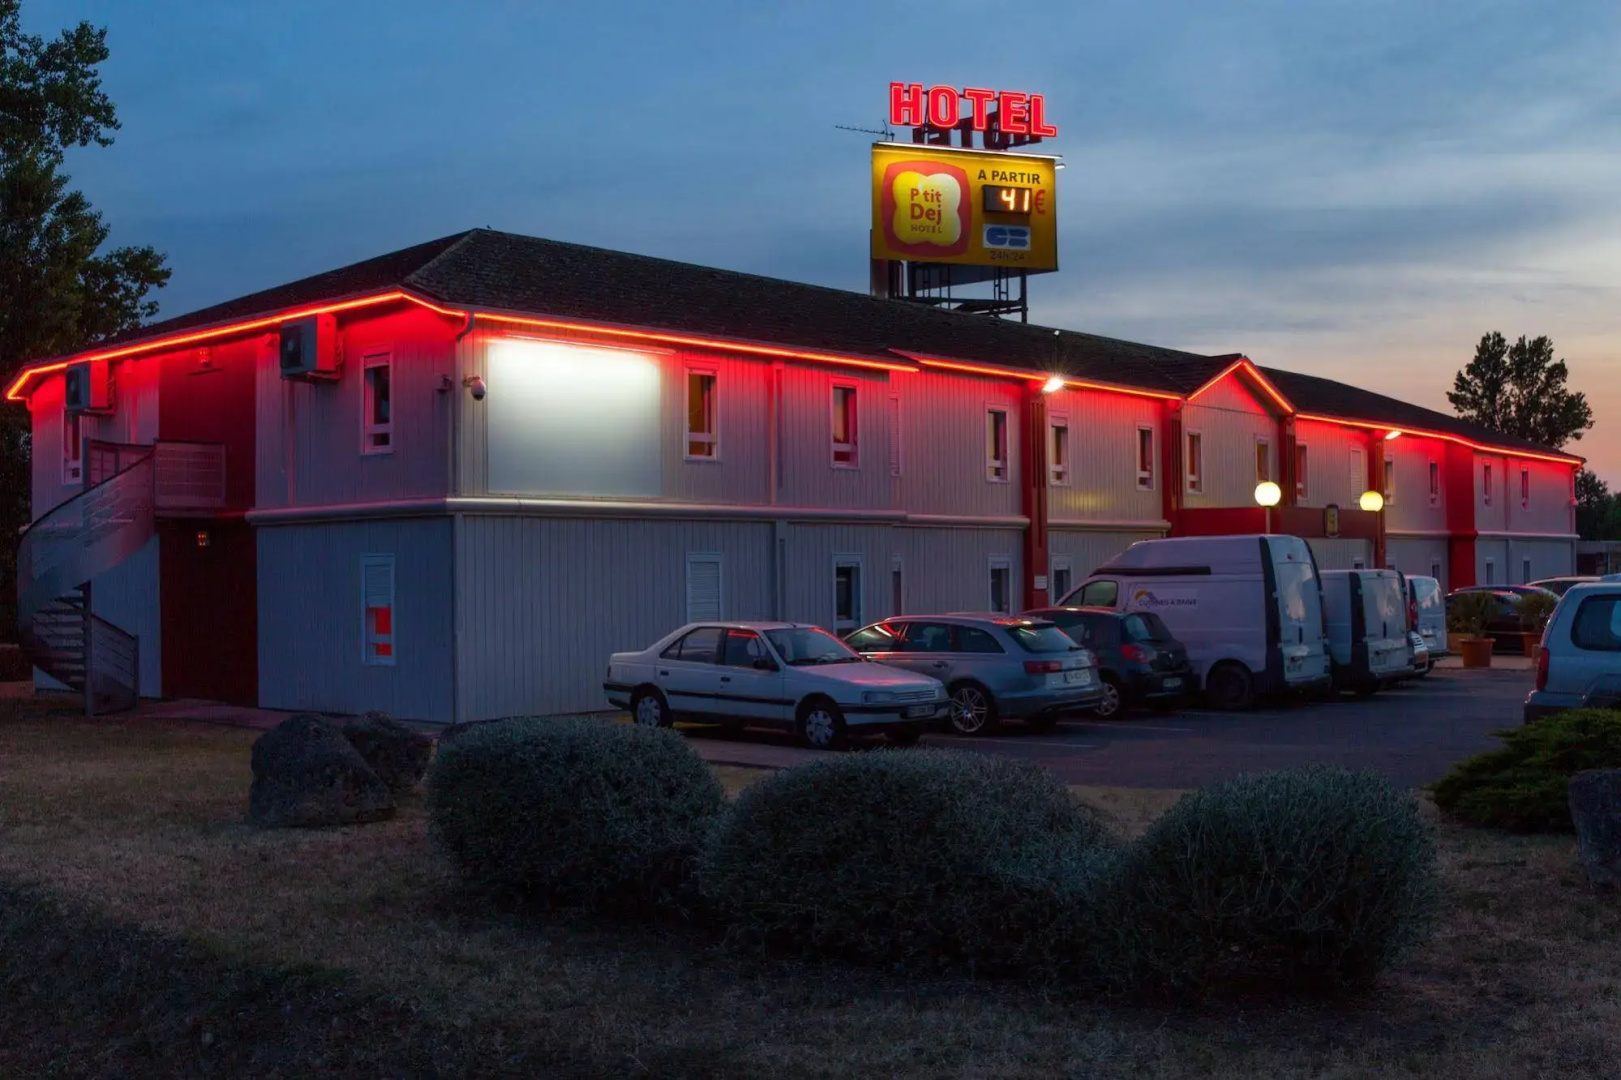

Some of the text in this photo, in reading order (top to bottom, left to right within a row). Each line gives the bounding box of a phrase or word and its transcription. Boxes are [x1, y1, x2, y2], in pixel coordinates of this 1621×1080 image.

[890, 82, 1057, 137] HOTEL
[991, 170, 1041, 185] PARTIR
[1001, 188, 1030, 211] 41
[910, 203, 942, 225] Dej
[910, 224, 943, 233] HOTEL
